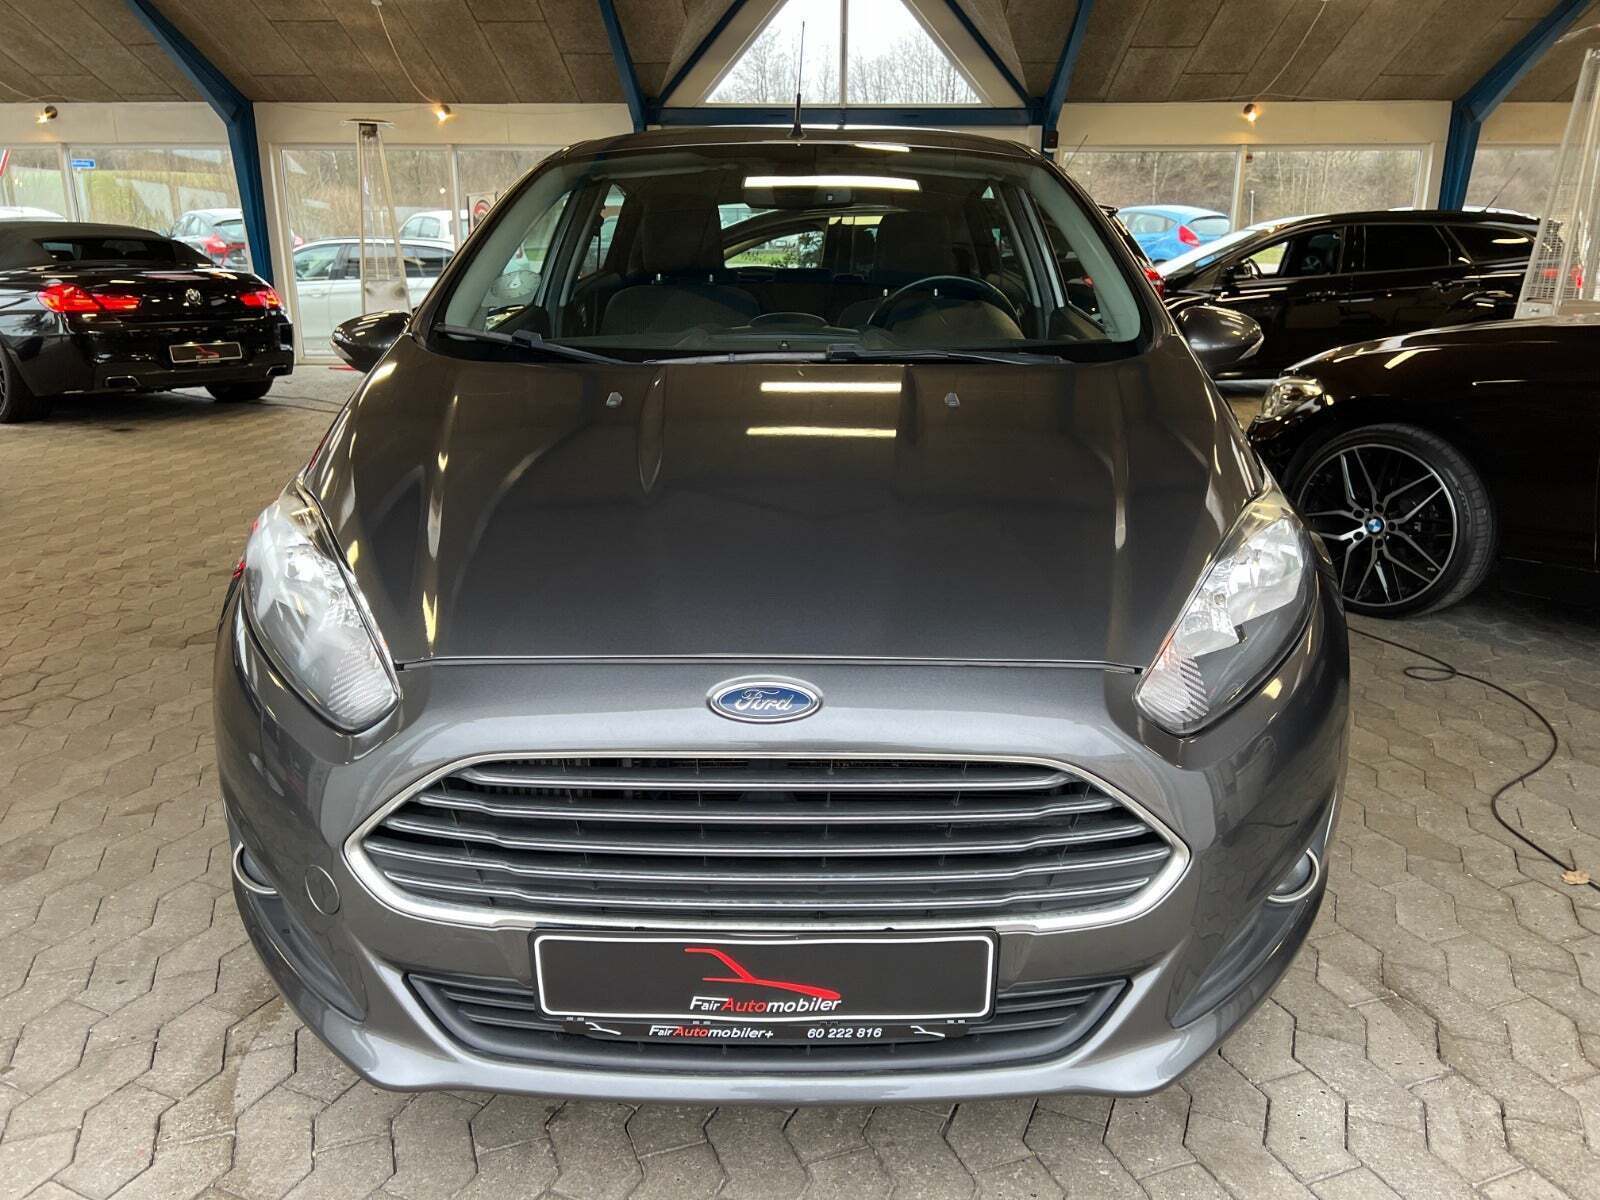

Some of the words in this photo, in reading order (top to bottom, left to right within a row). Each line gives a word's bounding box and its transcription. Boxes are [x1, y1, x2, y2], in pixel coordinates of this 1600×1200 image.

[735, 689, 794, 711] Ford
[807, 1028, 825, 1039] 60
[827, 1027, 853, 1039] 222
[856, 1027, 882, 1038] 816
